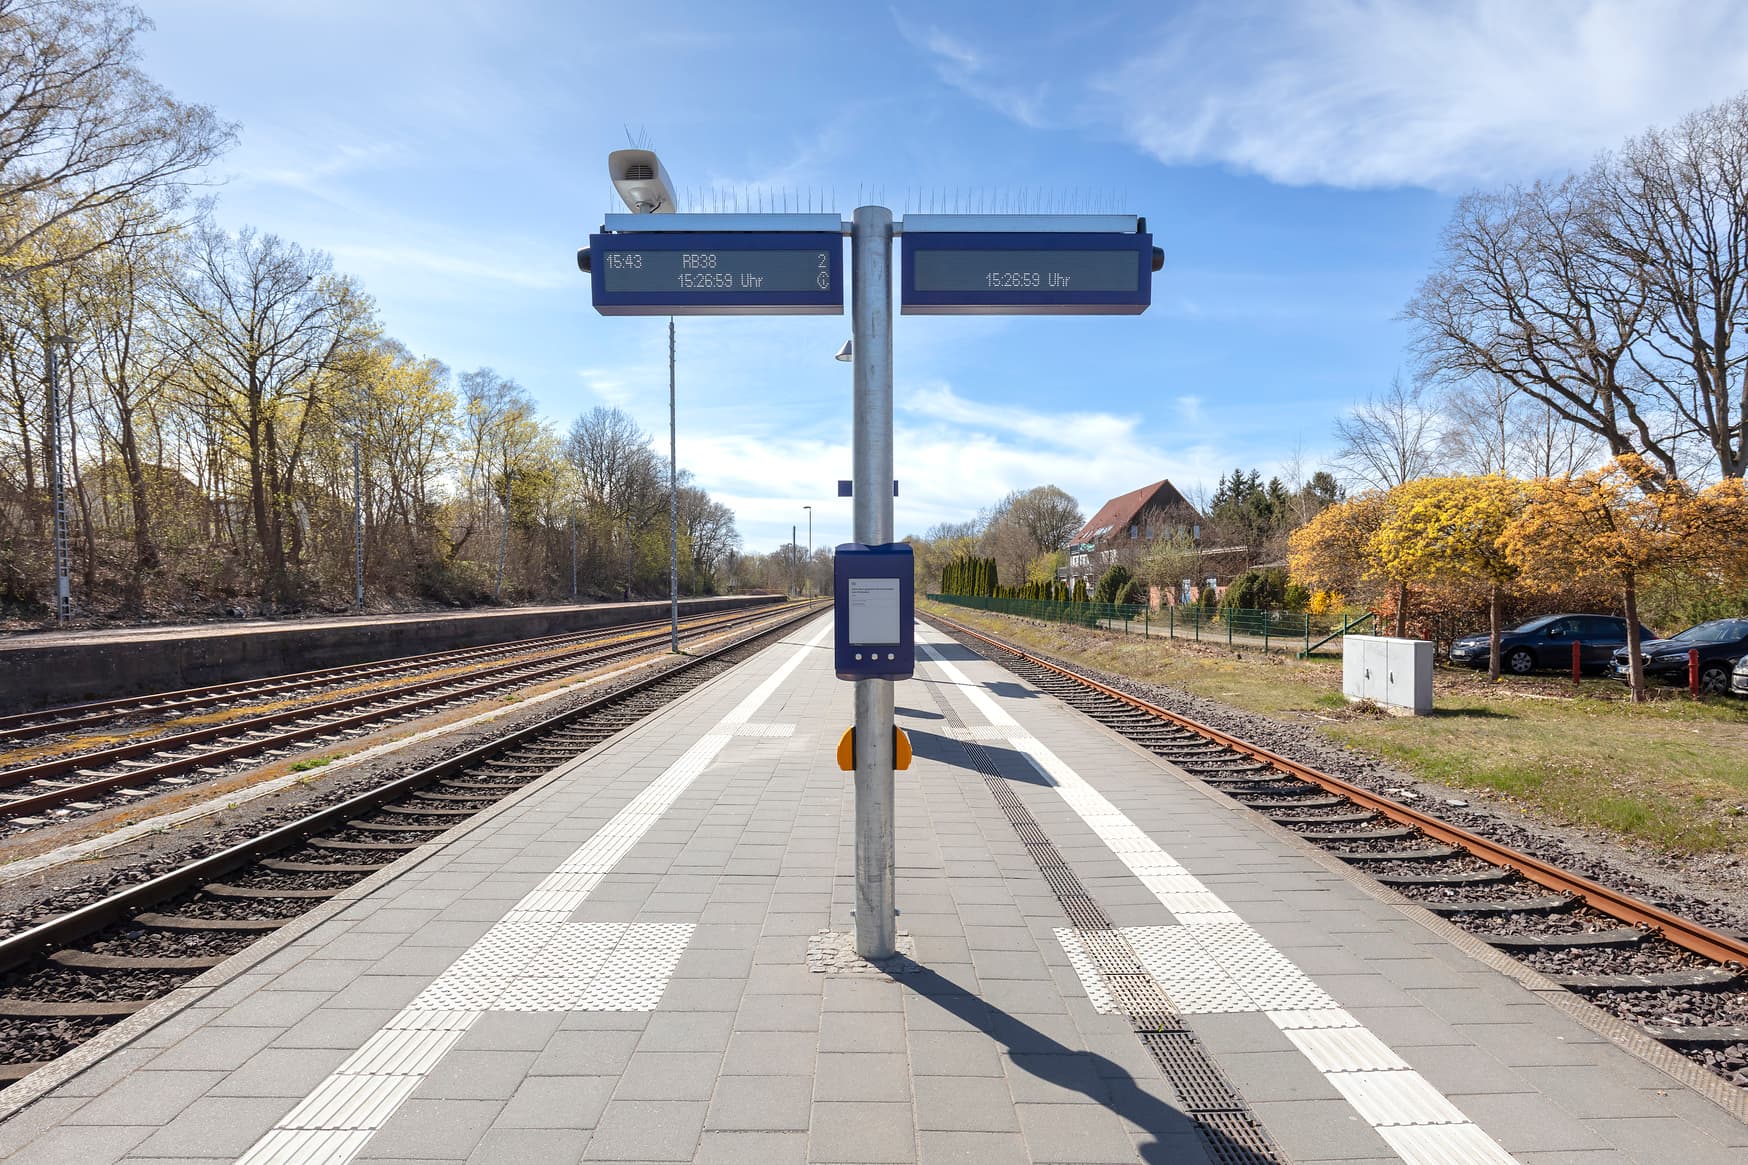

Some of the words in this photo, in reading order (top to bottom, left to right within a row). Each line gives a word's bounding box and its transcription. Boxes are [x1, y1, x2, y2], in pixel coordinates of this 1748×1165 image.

[606, 254, 643, 269] 15:43
[682, 253, 717, 269] RB38
[817, 253, 827, 268] 2
[677, 273, 733, 288] 15:26:59
[740, 273, 763, 288] Uhr
[985, 272, 1041, 288] 15:26:59
[1047, 272, 1071, 287] Uhr
